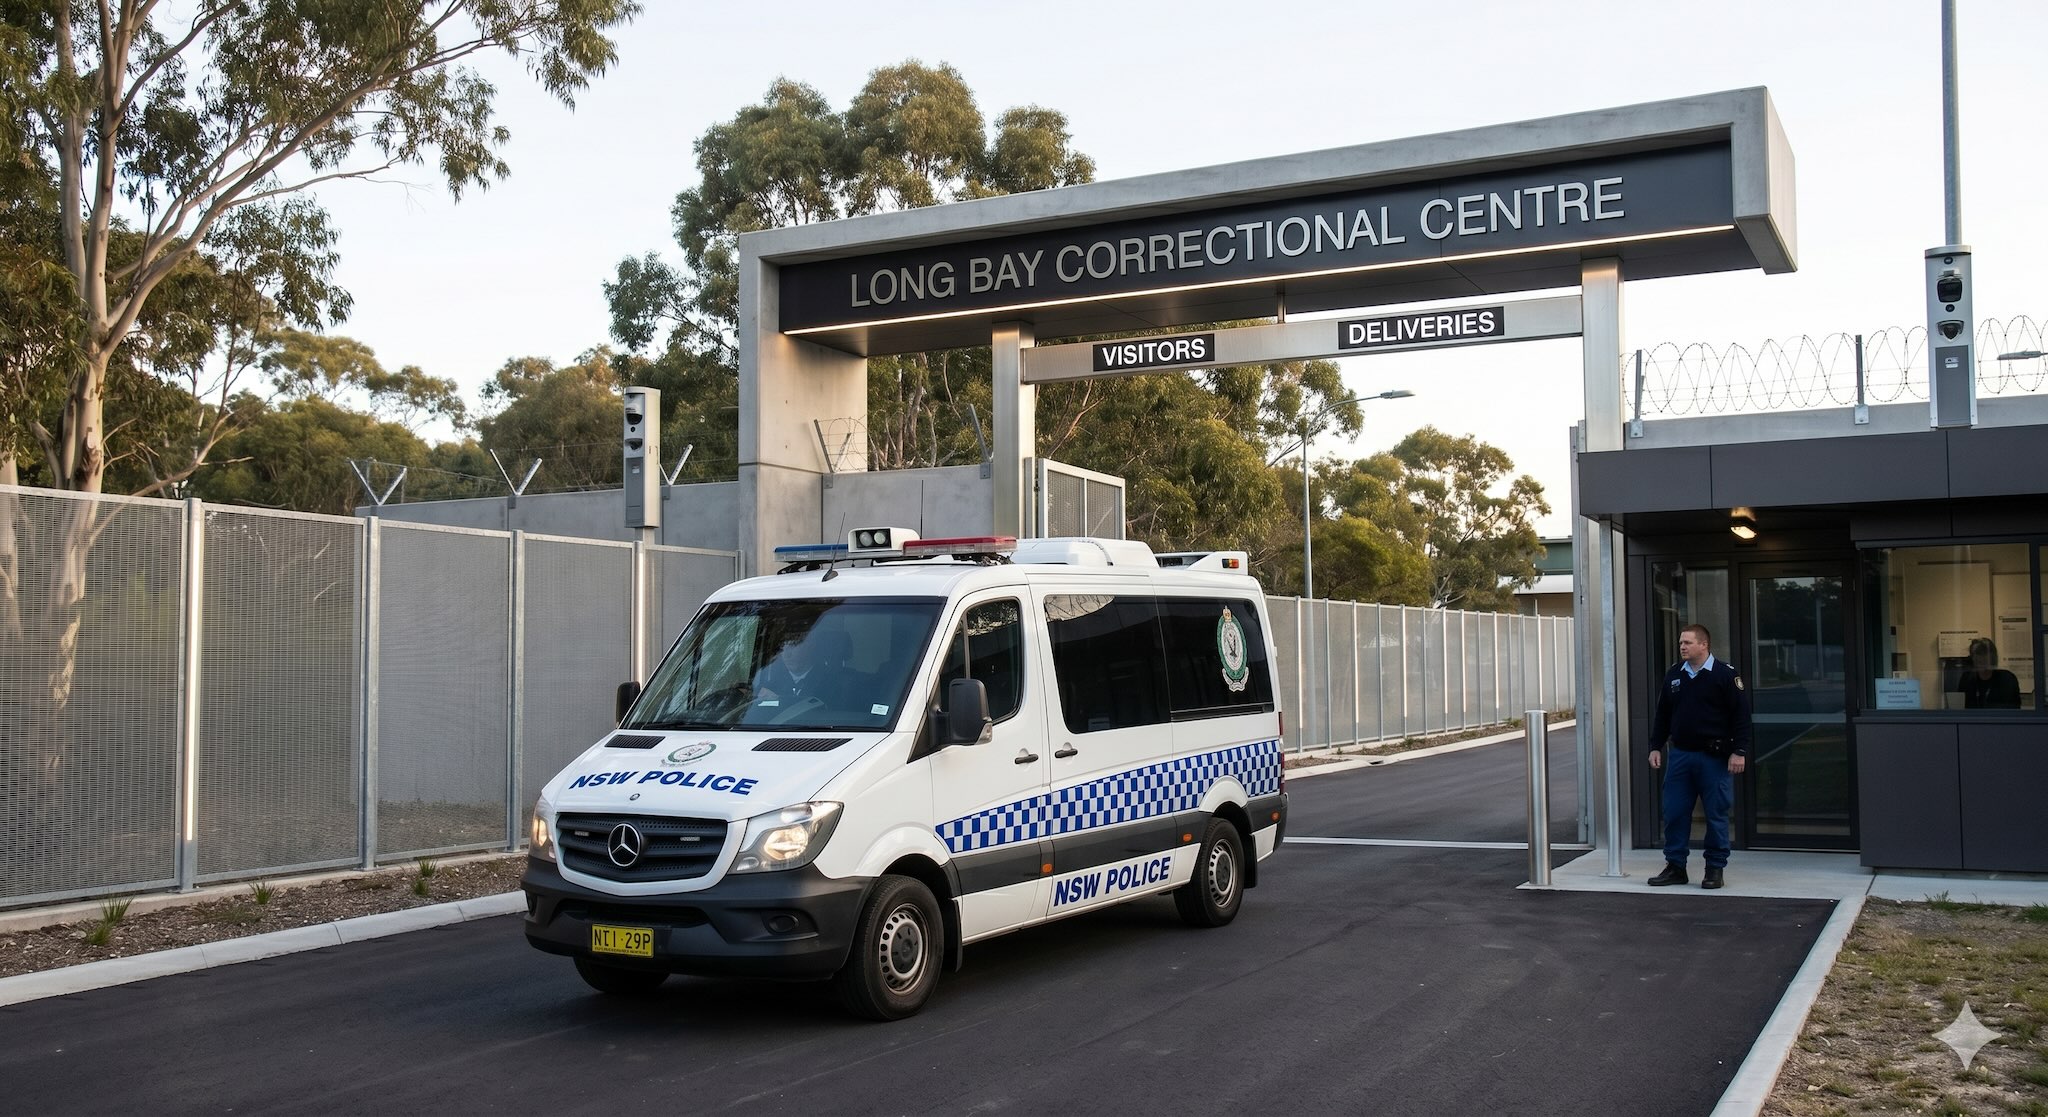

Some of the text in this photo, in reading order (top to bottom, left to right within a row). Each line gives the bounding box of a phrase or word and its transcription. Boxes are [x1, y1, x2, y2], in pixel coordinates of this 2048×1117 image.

[851, 177, 1625, 308] LONG BAY CORRECTIONAL CENTRE
[1349, 311, 1496, 345] DELIVERIES
[1102, 338, 1206, 367] VISITORS
[568, 770, 759, 796] NSW POLICE
[1053, 856, 1171, 907] NSW POLICE
